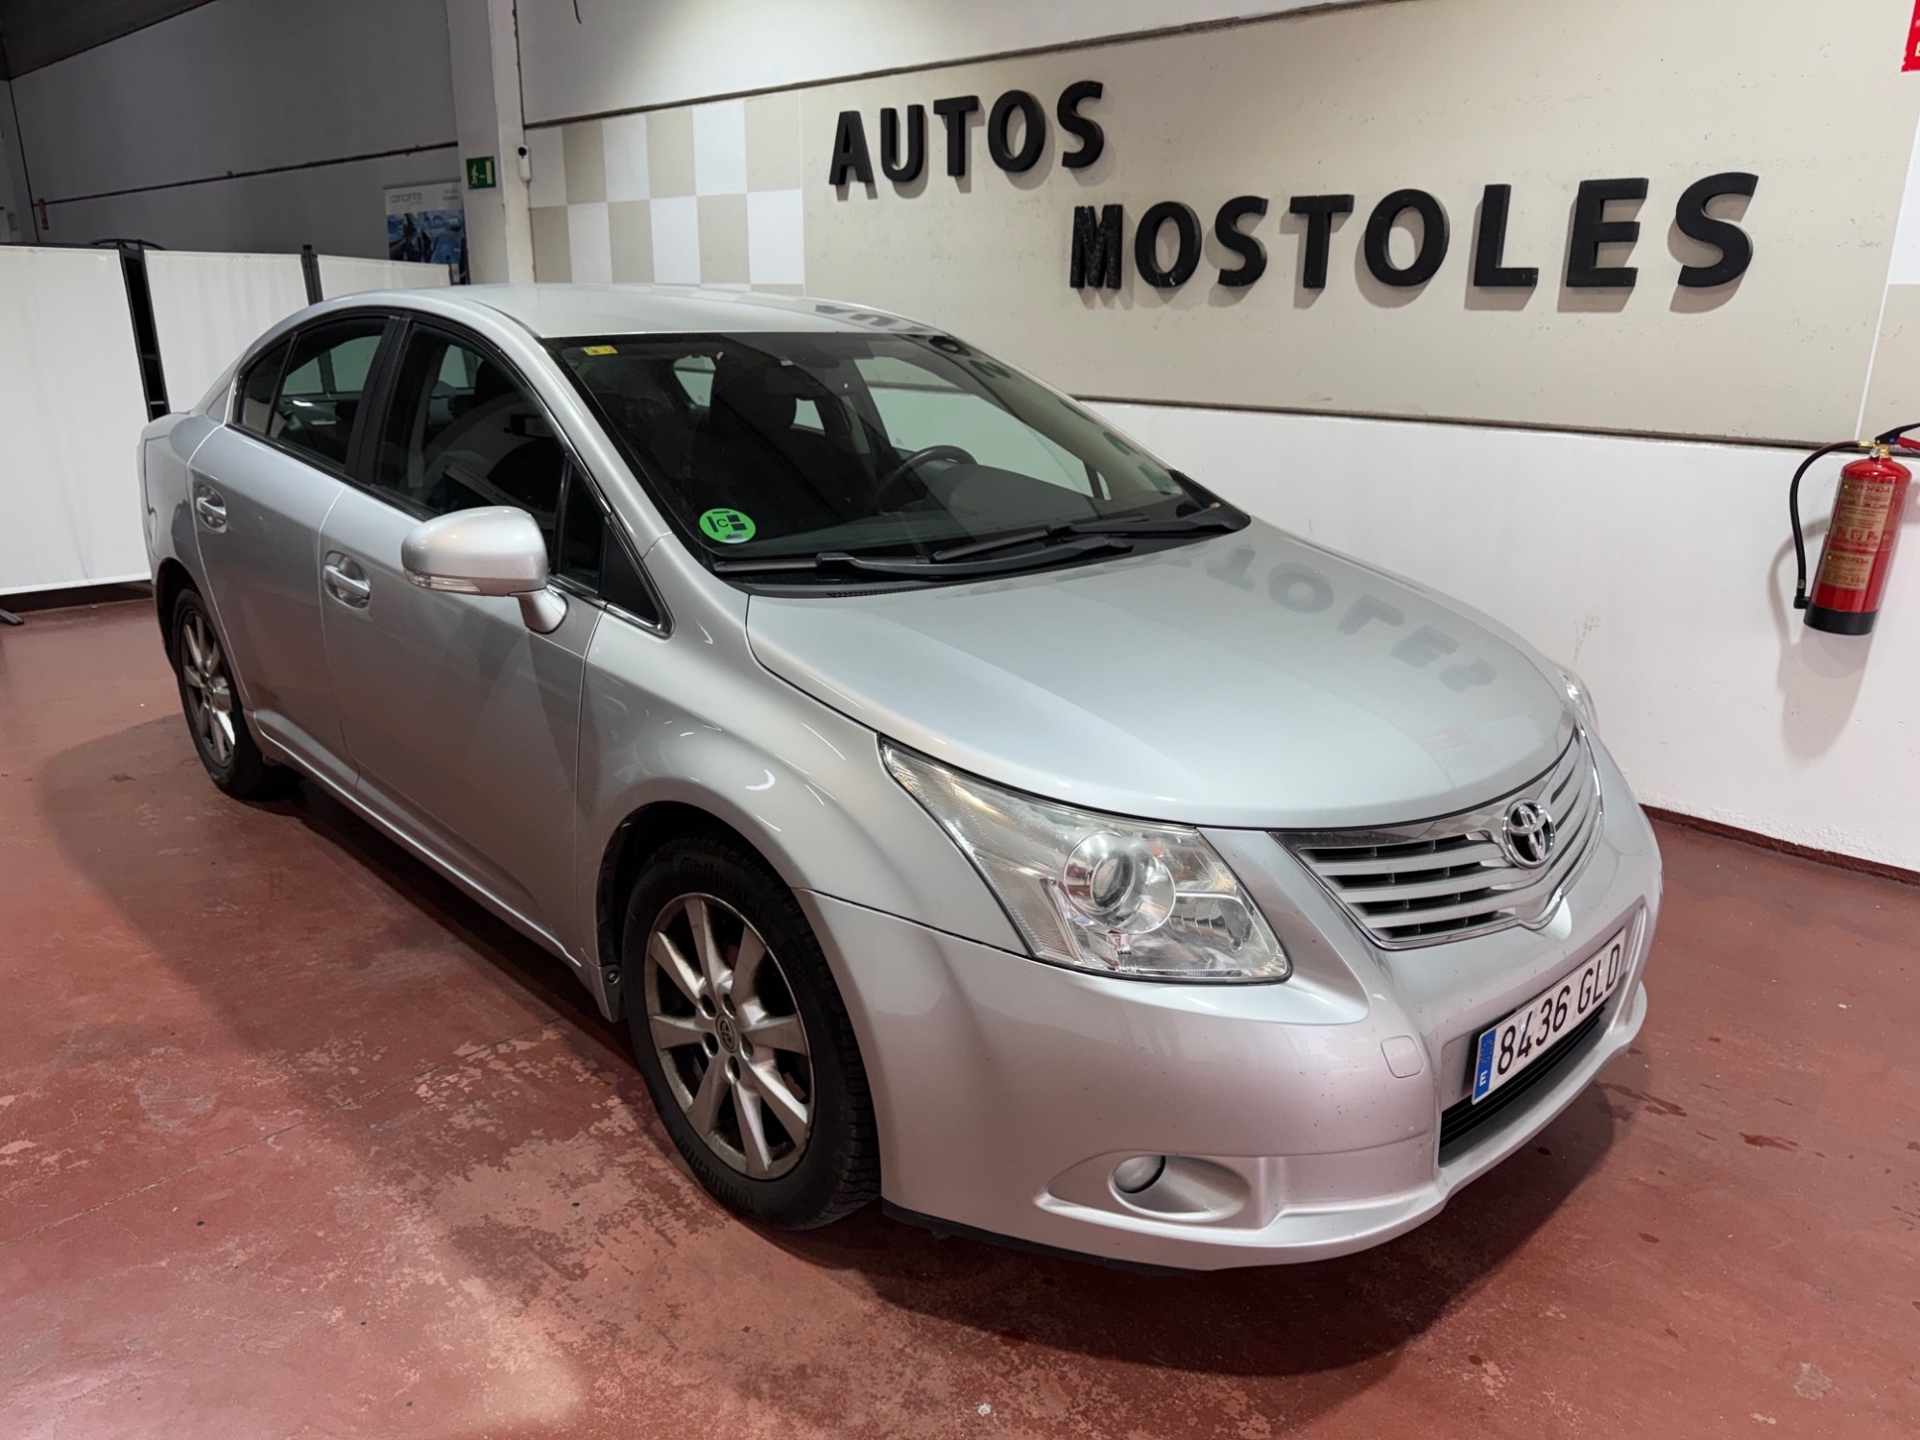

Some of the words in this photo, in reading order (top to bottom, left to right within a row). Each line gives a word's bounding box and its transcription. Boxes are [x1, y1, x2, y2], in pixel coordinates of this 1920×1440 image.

[829, 80, 1105, 186] AUTOS
[1070, 171, 1759, 290] MOSTOLES
[716, 518, 729, 528] C
[1479, 1069, 1489, 1087] E
[1497, 984, 1571, 1076] 8436
[1577, 943, 1621, 1015] GLD
